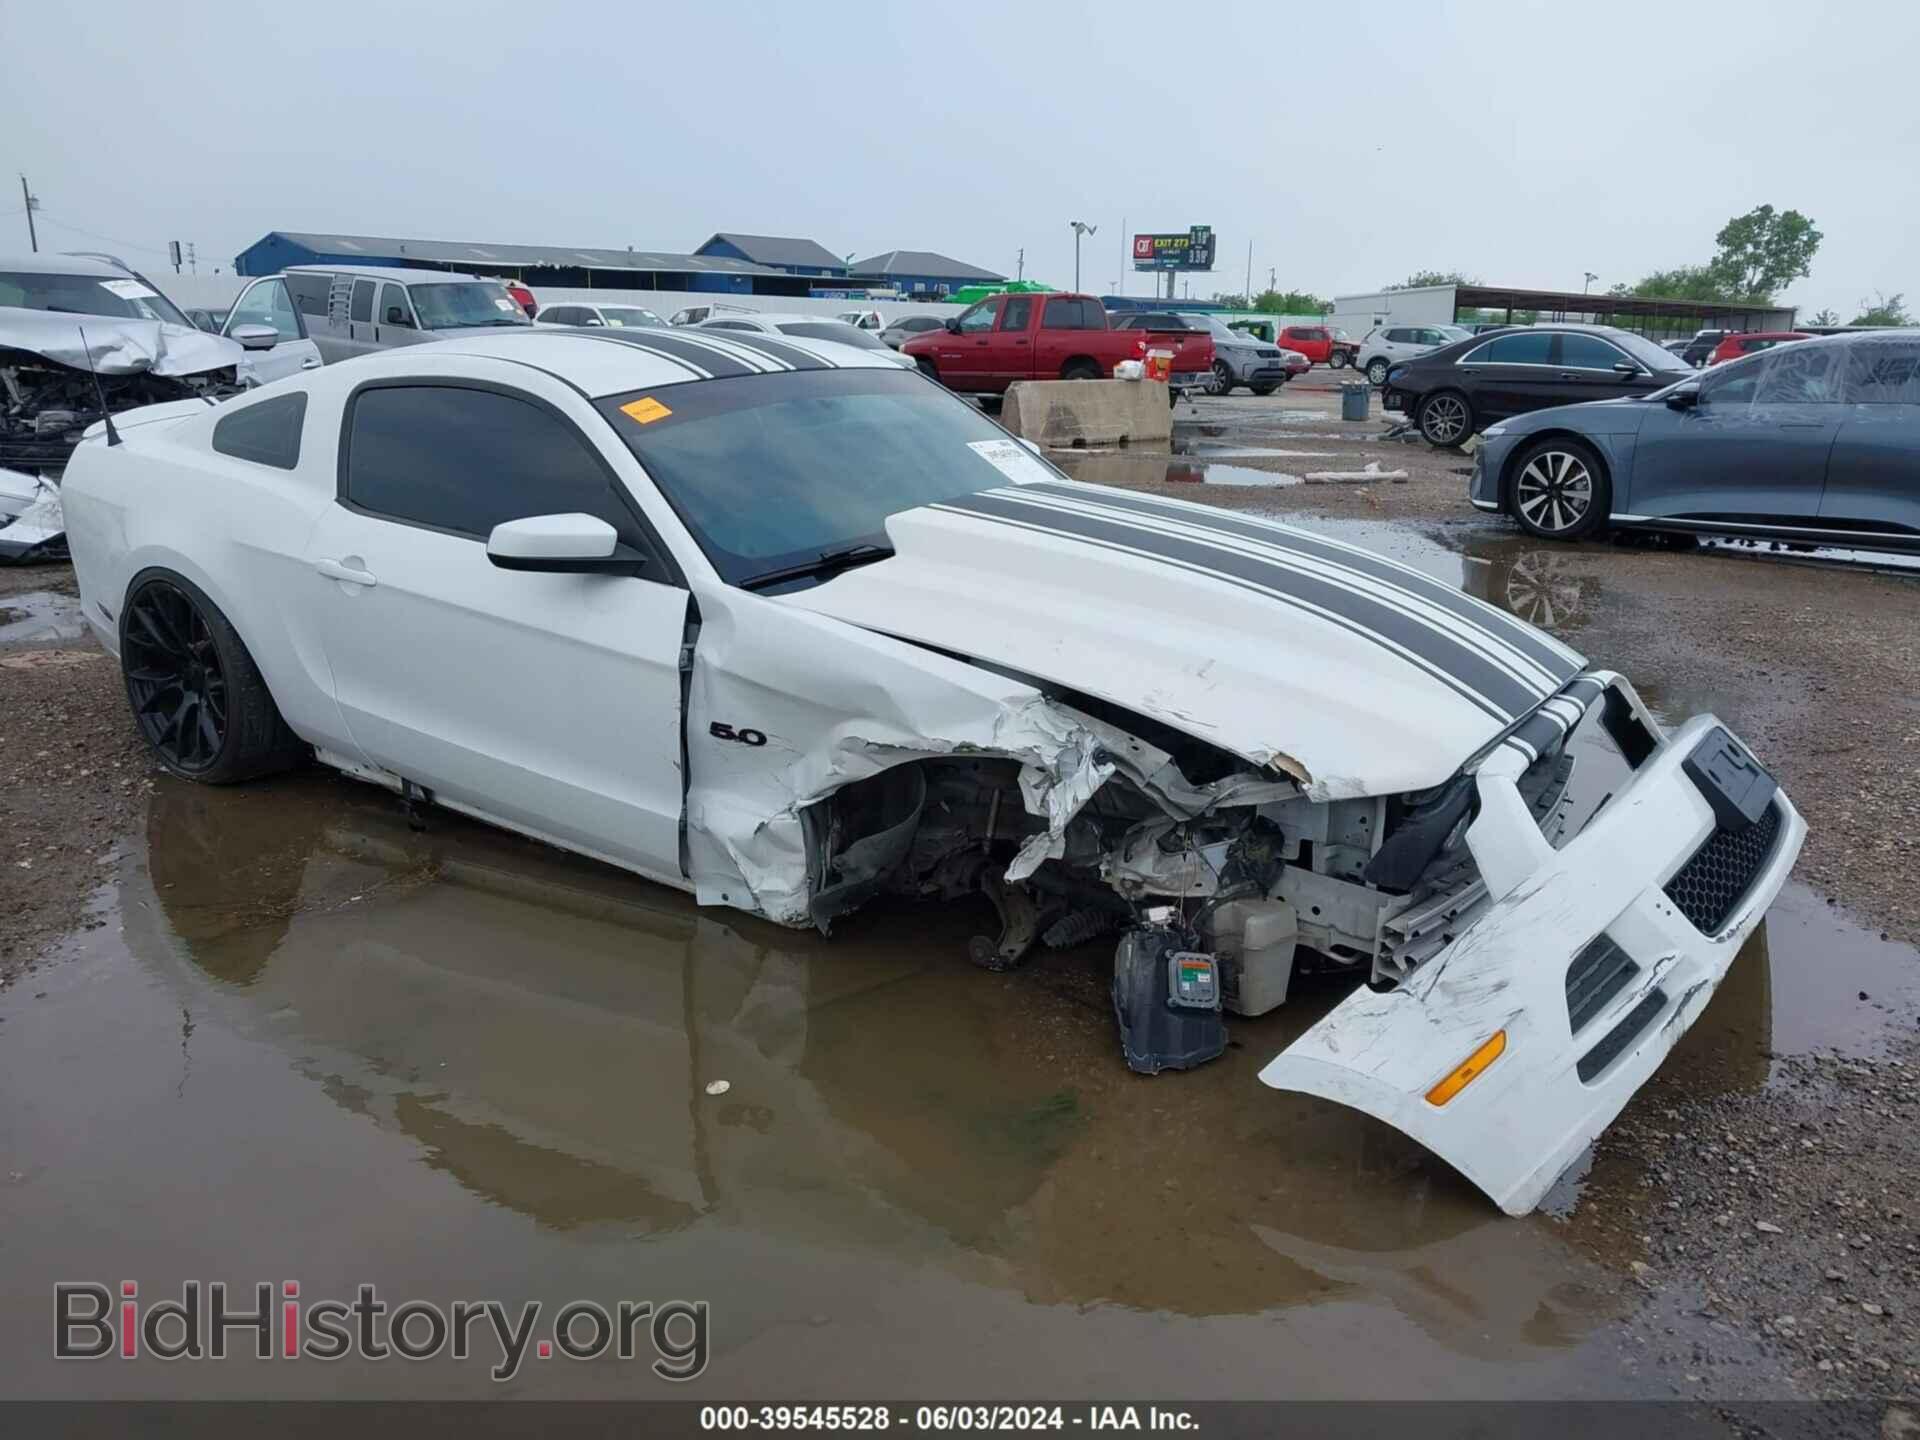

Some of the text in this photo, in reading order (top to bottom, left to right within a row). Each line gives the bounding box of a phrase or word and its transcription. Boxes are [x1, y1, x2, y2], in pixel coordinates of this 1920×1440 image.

[1136, 239, 1152, 253] QT
[1154, 239, 1173, 248] EXIT
[1174, 238, 1189, 249] 273
[709, 721, 767, 746] 5.0
